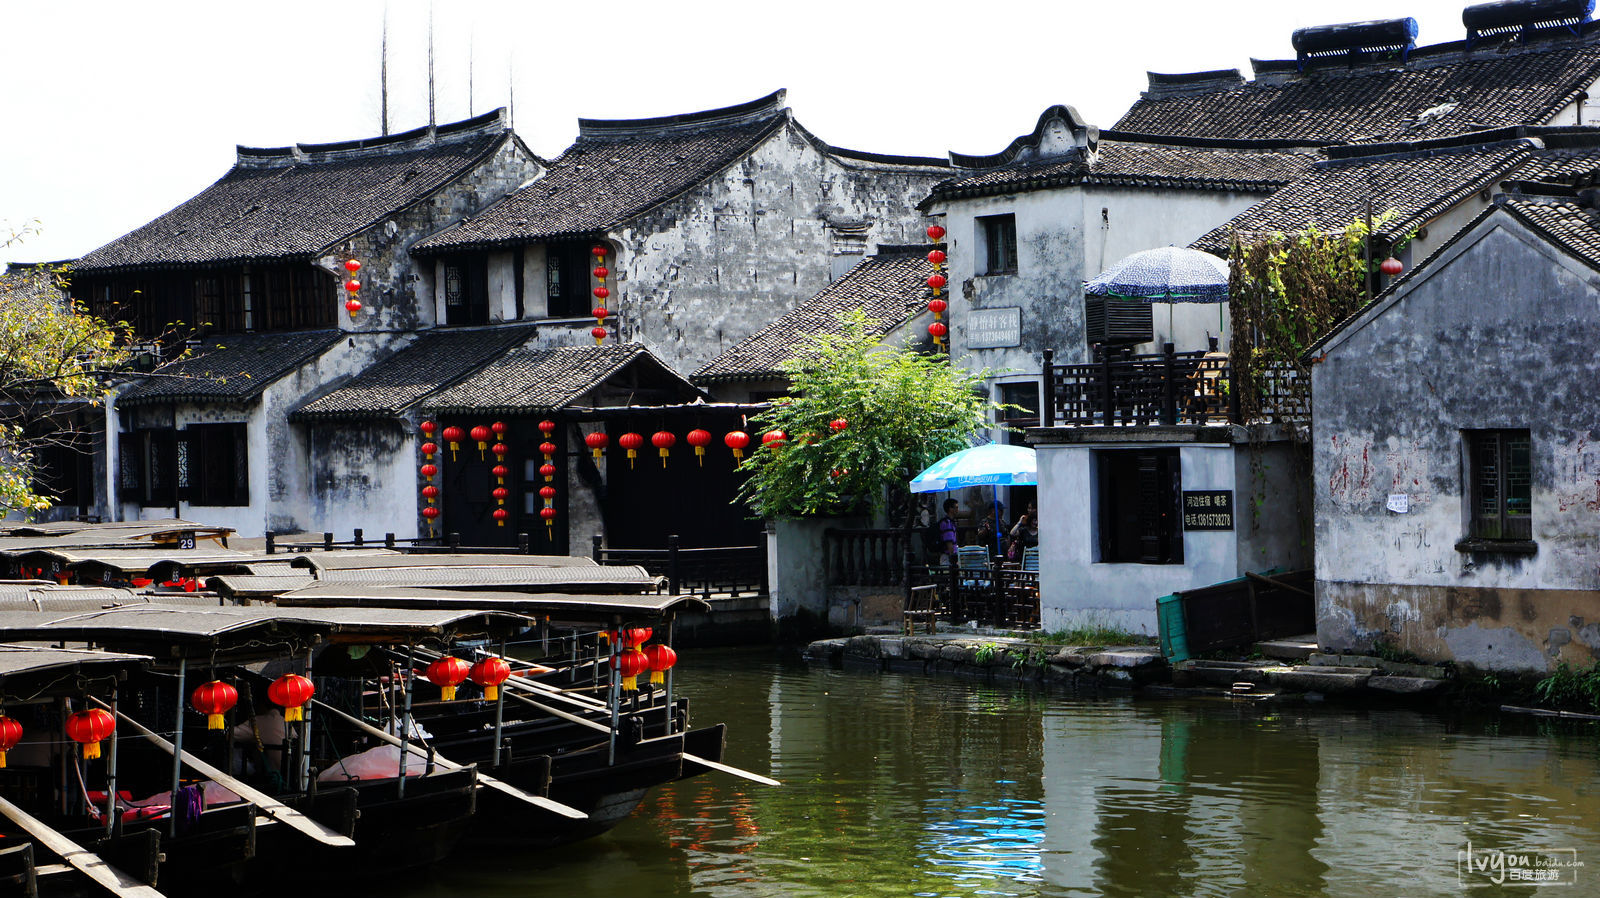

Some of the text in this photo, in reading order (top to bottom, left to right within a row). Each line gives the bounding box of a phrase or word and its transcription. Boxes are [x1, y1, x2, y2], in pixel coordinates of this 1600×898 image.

[1187, 495, 1210, 507] 河边住宿
[180, 538, 194, 549] 29
